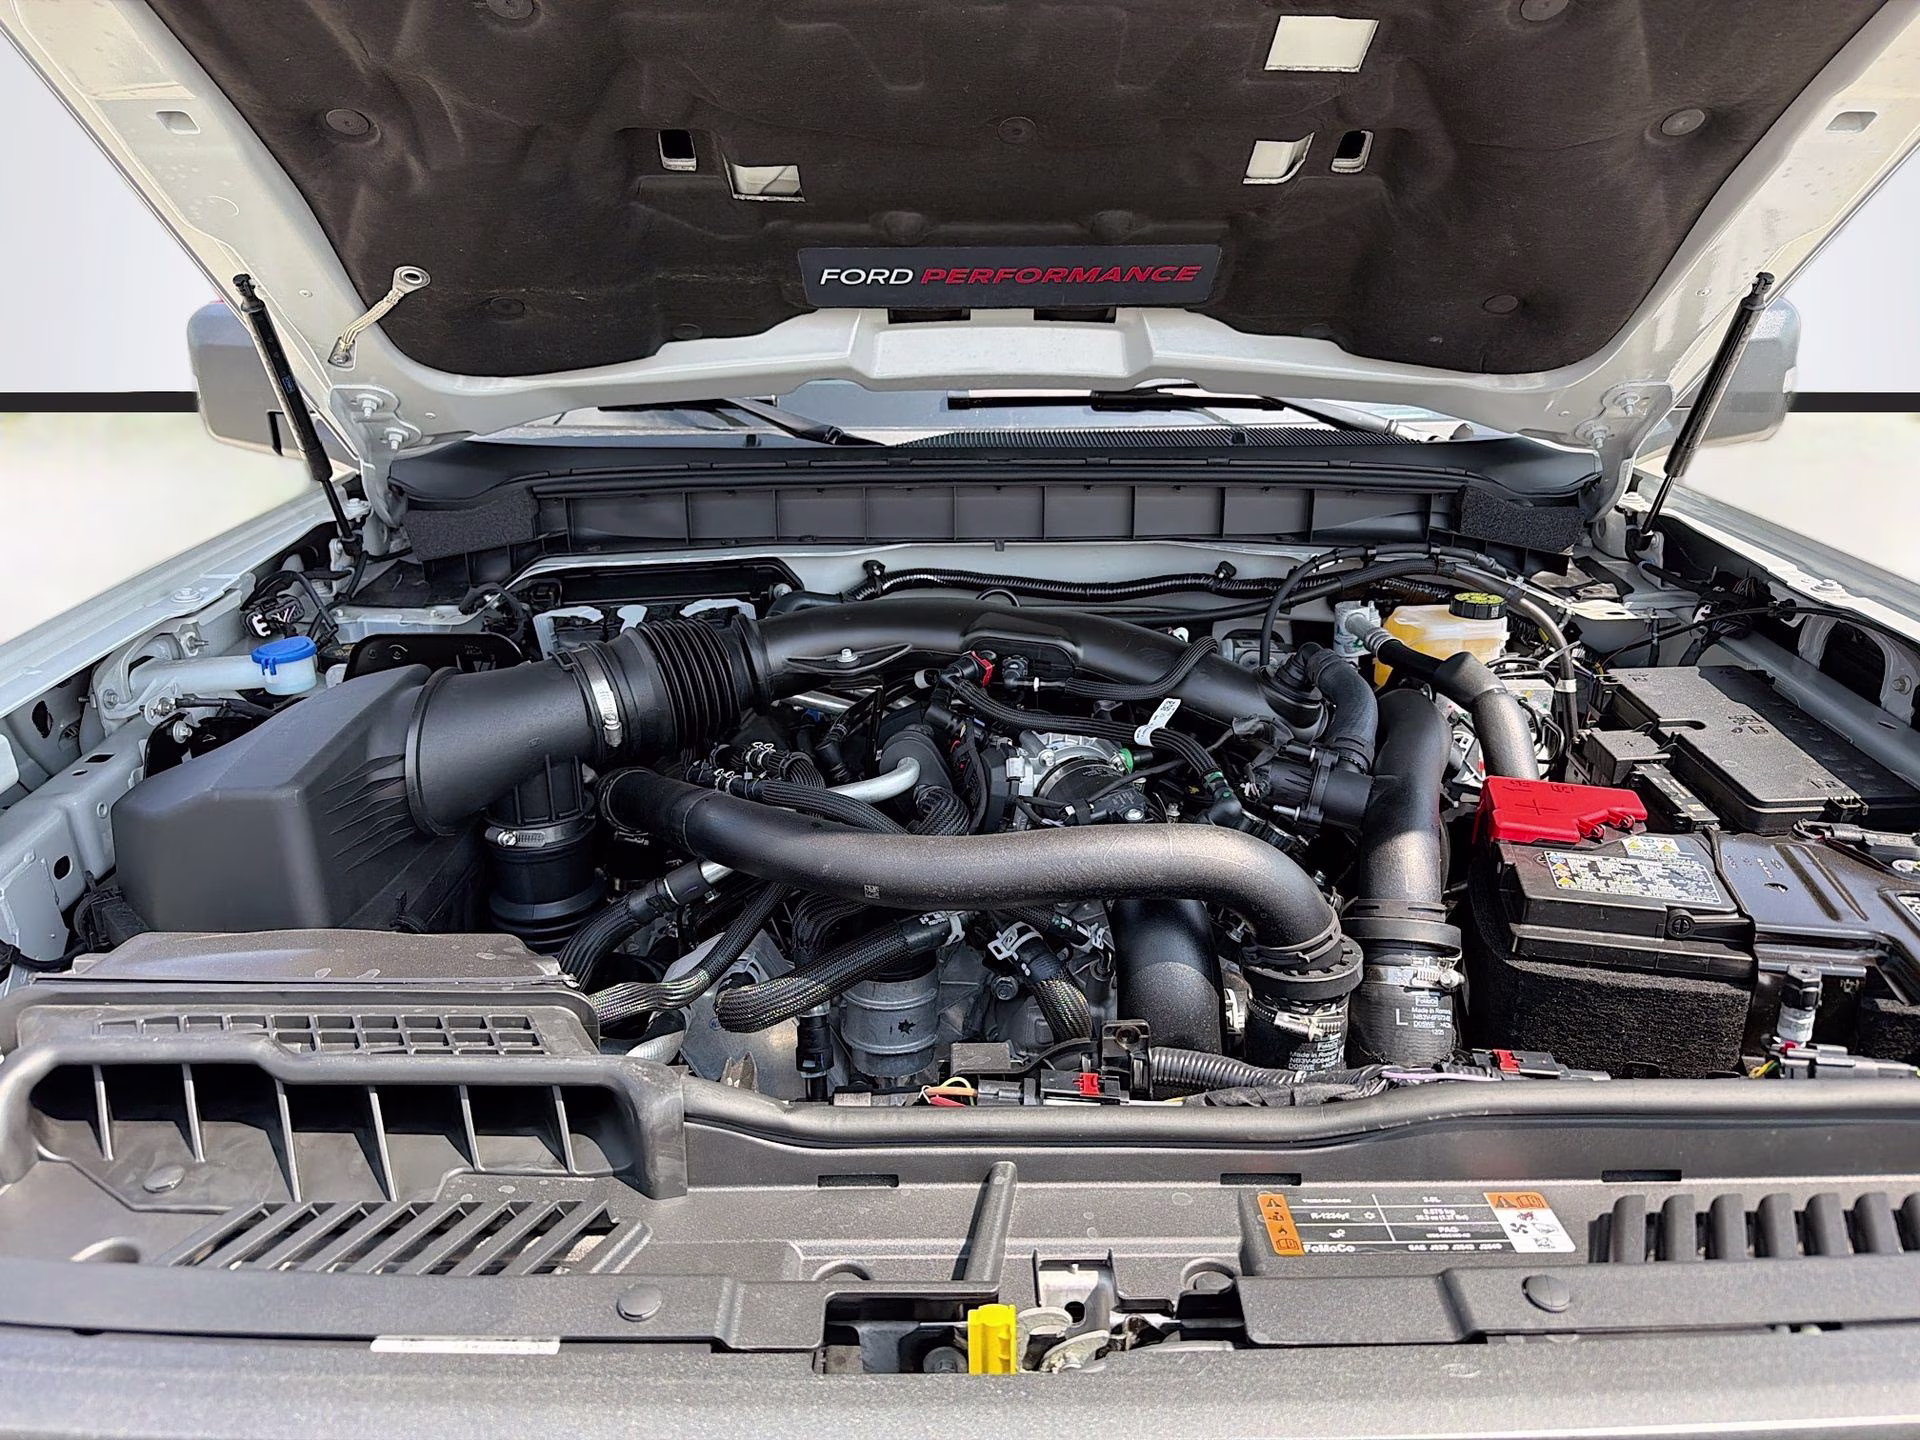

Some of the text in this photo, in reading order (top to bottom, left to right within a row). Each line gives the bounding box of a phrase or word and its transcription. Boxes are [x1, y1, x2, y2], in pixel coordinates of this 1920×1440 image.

[819, 265, 1202, 286] FORD PERFORMANCE
[1395, 1008, 1408, 1025] L
[1302, 1244, 1356, 1253] FoMoCo
